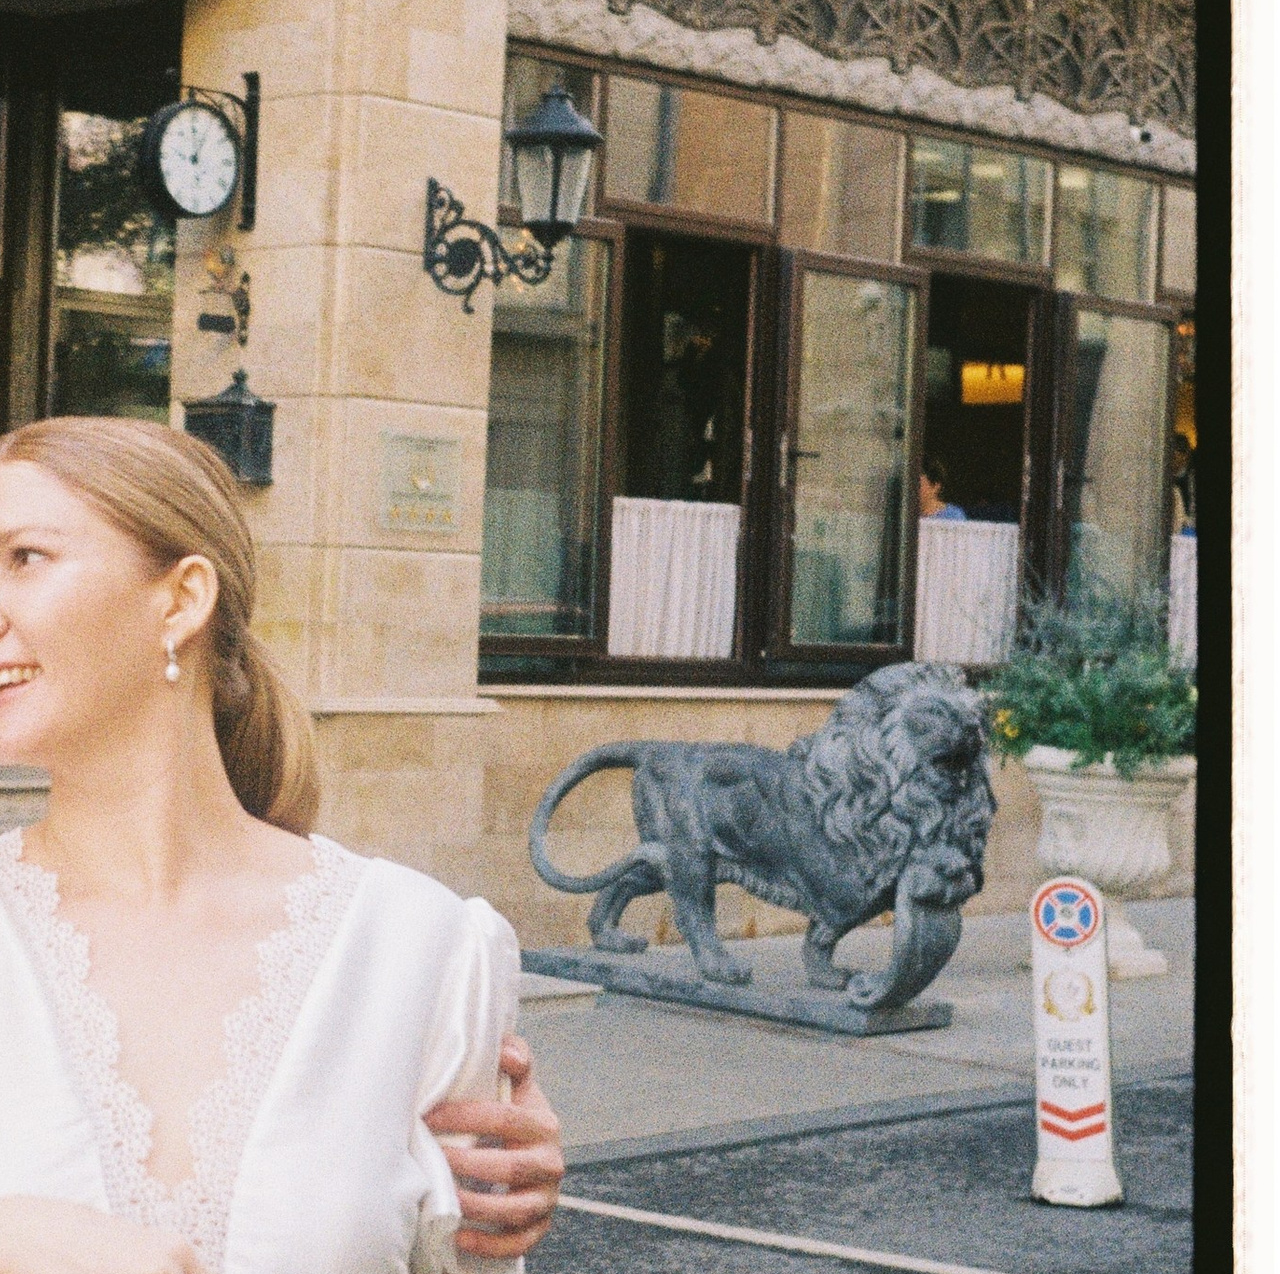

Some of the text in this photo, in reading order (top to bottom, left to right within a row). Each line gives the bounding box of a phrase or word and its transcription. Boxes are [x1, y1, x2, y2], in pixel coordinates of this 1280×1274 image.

[1047, 1038, 1092, 1052] GUEST
[1041, 1056, 1101, 1071] PARKING
[1052, 1076, 1089, 1089] ONLY
